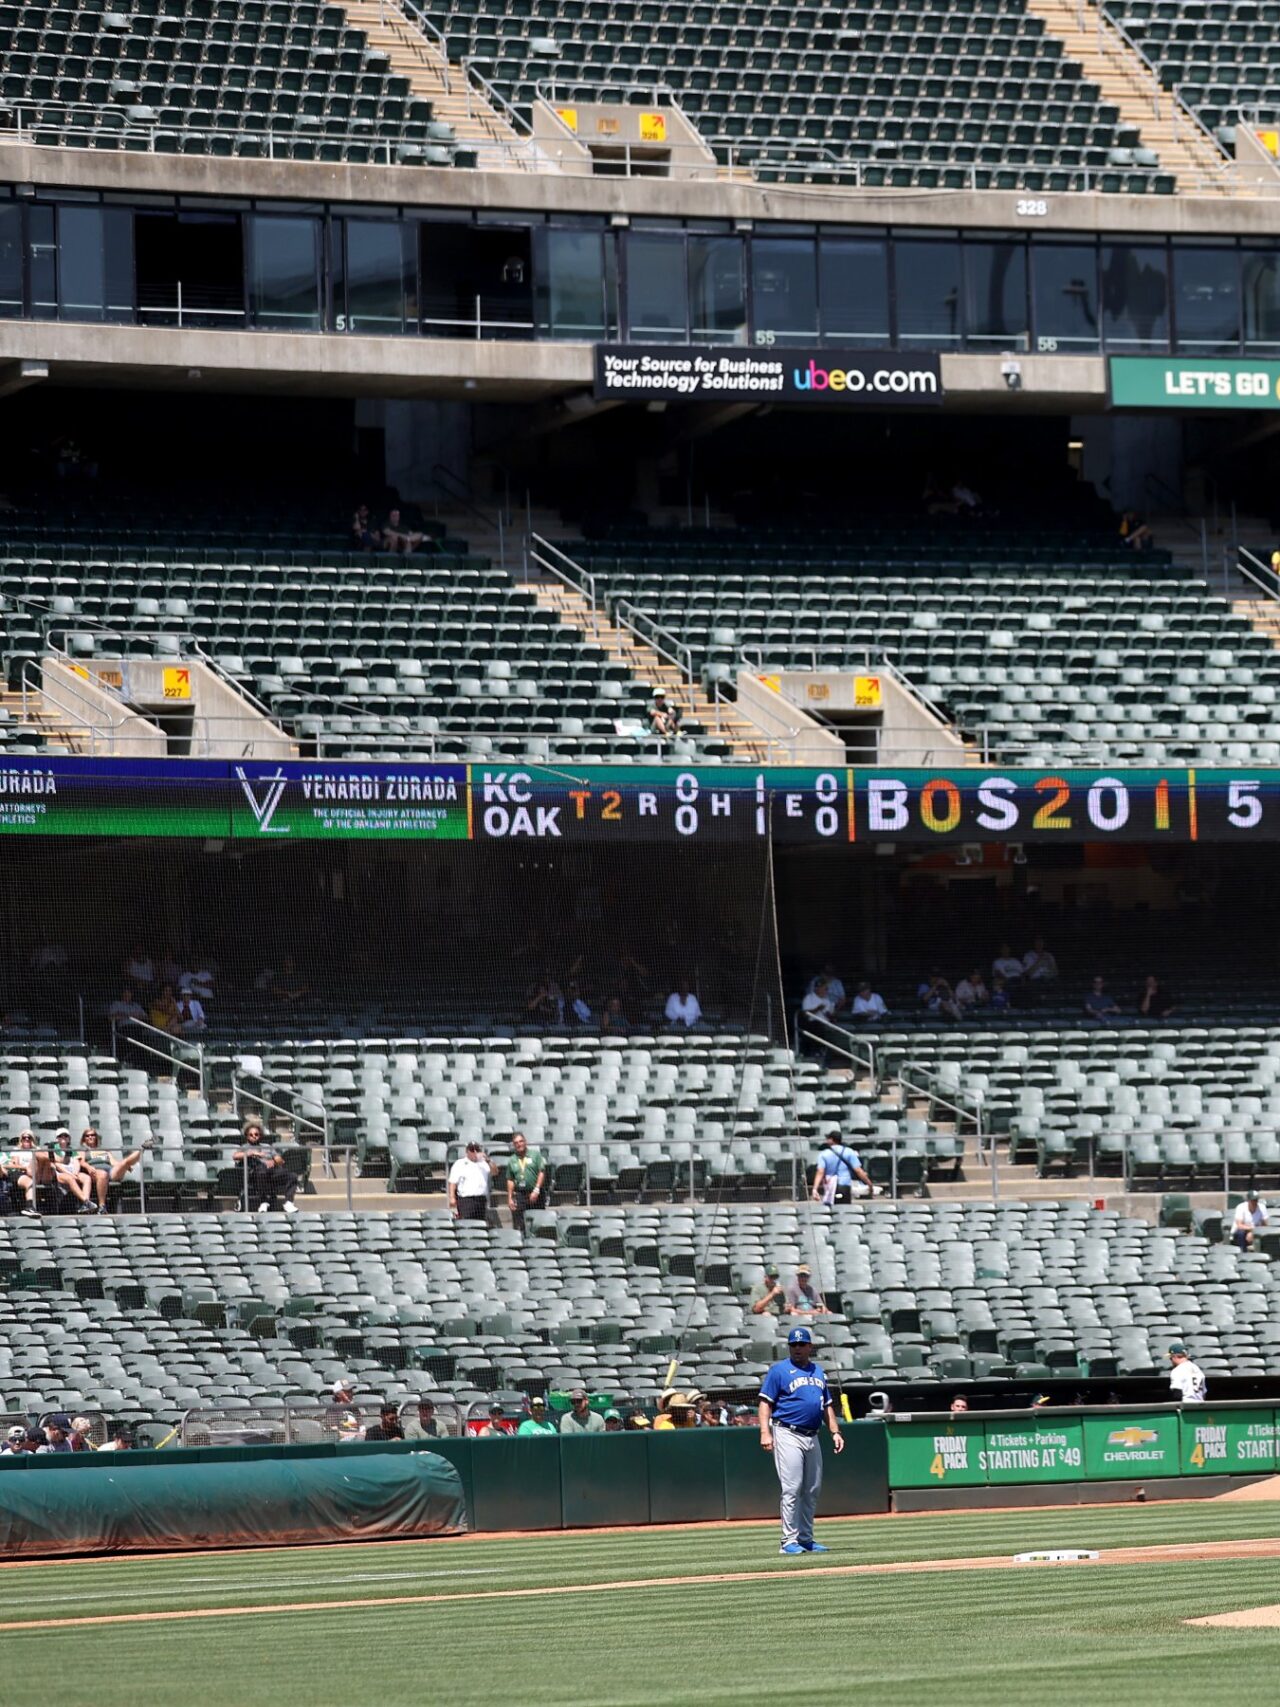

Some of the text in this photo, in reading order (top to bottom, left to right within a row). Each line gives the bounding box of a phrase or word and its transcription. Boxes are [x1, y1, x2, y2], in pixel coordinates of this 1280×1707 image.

[1016, 199, 1048, 216] 328
[755, 330, 776, 345] 55
[1037, 335, 1058, 351] 56
[604, 356, 782, 375] Your Source for Business
[793, 359, 937, 393] ubeo.com
[605, 372, 784, 393] Technology Solutions!
[1165, 371, 1232, 395] LET'S
[1235, 372, 1270, 396] GO
[165, 688, 182, 697] 227
[302, 773, 458, 801] VENARDI ZURADA
[483, 772, 533, 802] KC
[313, 808, 328, 818] THE
[638, 792, 658, 816] R
[711, 793, 731, 816] H
[785, 793, 803, 817] E
[1227, 780, 1264, 829] 5
[336, 818, 351, 829] THE
[483, 806, 562, 837] OAK
[990, 1434, 997, 1447] 4
[998, 1433, 1028, 1447] Tickets
[1035, 1432, 1067, 1447] Parking
[1195, 1425, 1227, 1444] FRIDAY
[1247, 1424, 1254, 1437] 4
[933, 1436, 968, 1454] FRIDAY
[1190, 1442, 1228, 1469] 4 PACK
[929, 1452, 969, 1480] 4 PACK
[979, 1447, 1082, 1470] STARTING AT $49
[1103, 1450, 1166, 1462] CHEVROLET
